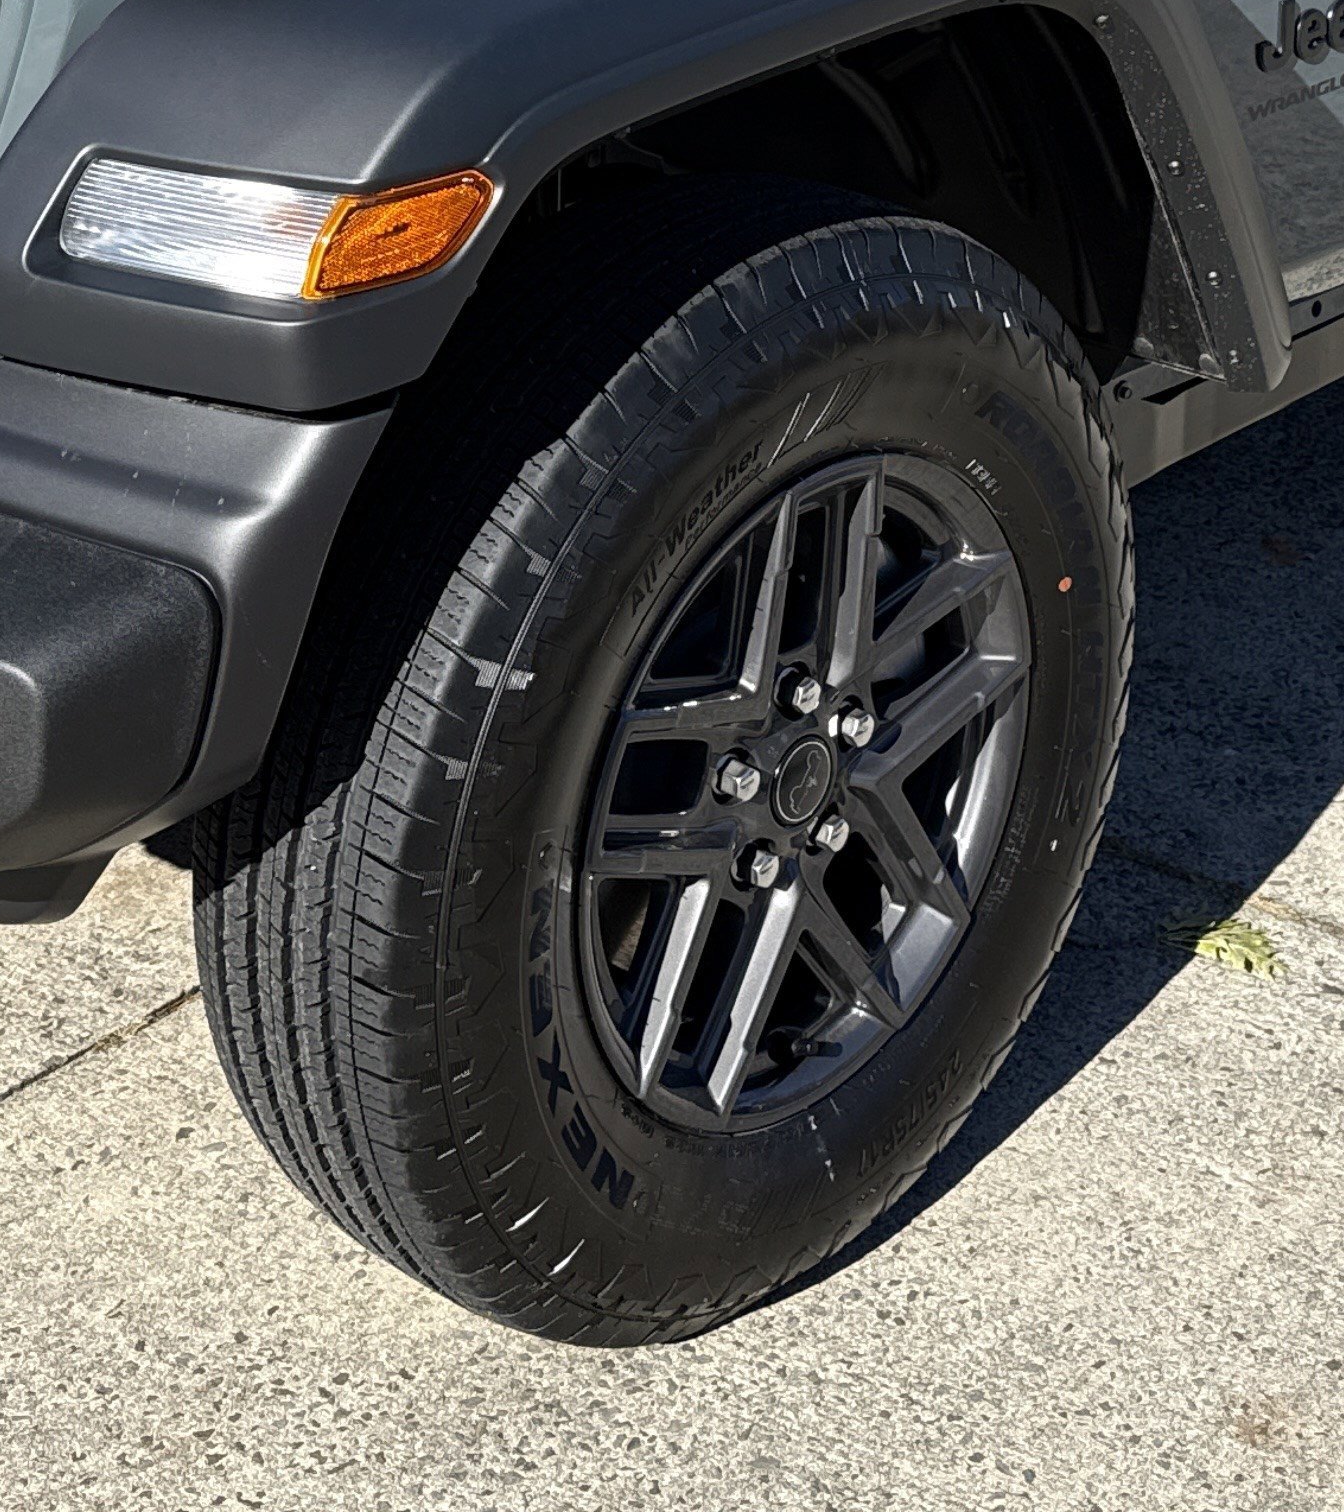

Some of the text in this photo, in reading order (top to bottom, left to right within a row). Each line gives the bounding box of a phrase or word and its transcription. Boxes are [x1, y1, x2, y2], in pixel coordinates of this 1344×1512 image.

[632, 440, 763, 617] All-Weather
[529, 878, 635, 1211] NEXEN
[857, 1047, 963, 1178] 245/75R17
